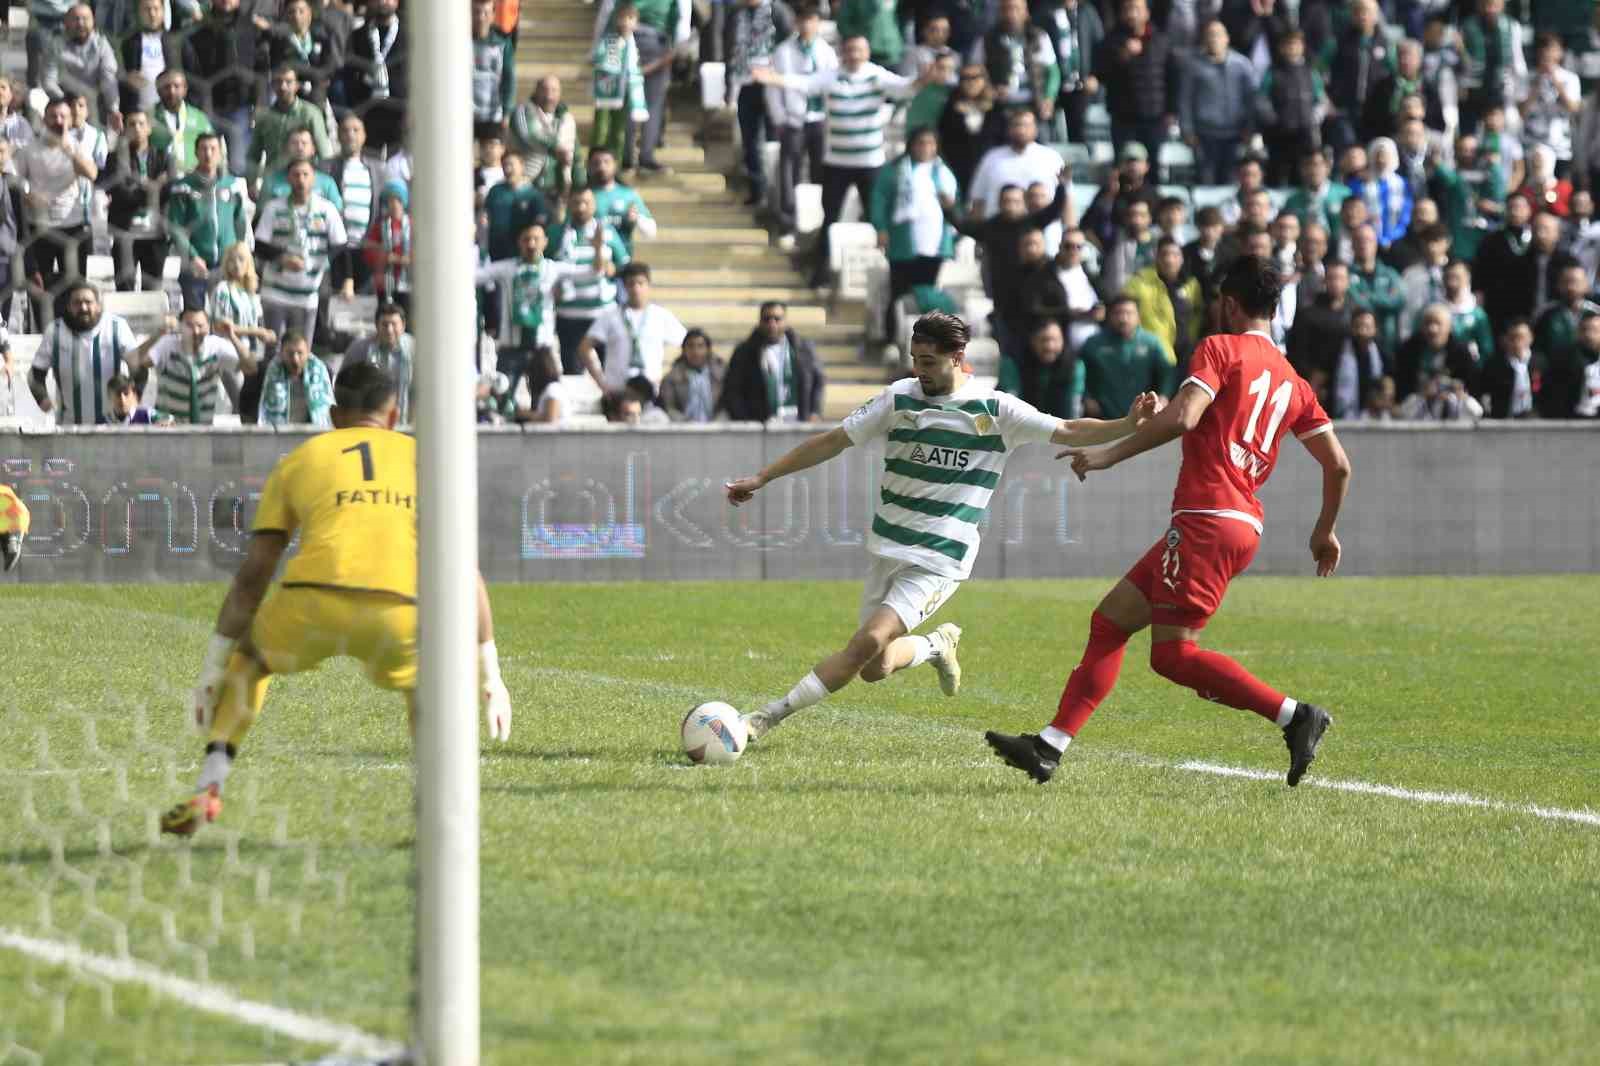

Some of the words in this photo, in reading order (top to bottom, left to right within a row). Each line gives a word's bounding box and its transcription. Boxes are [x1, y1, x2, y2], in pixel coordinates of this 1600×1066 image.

[1243, 369, 1294, 454] 11
[341, 440, 375, 481] 1
[1161, 549, 1180, 577] 11
